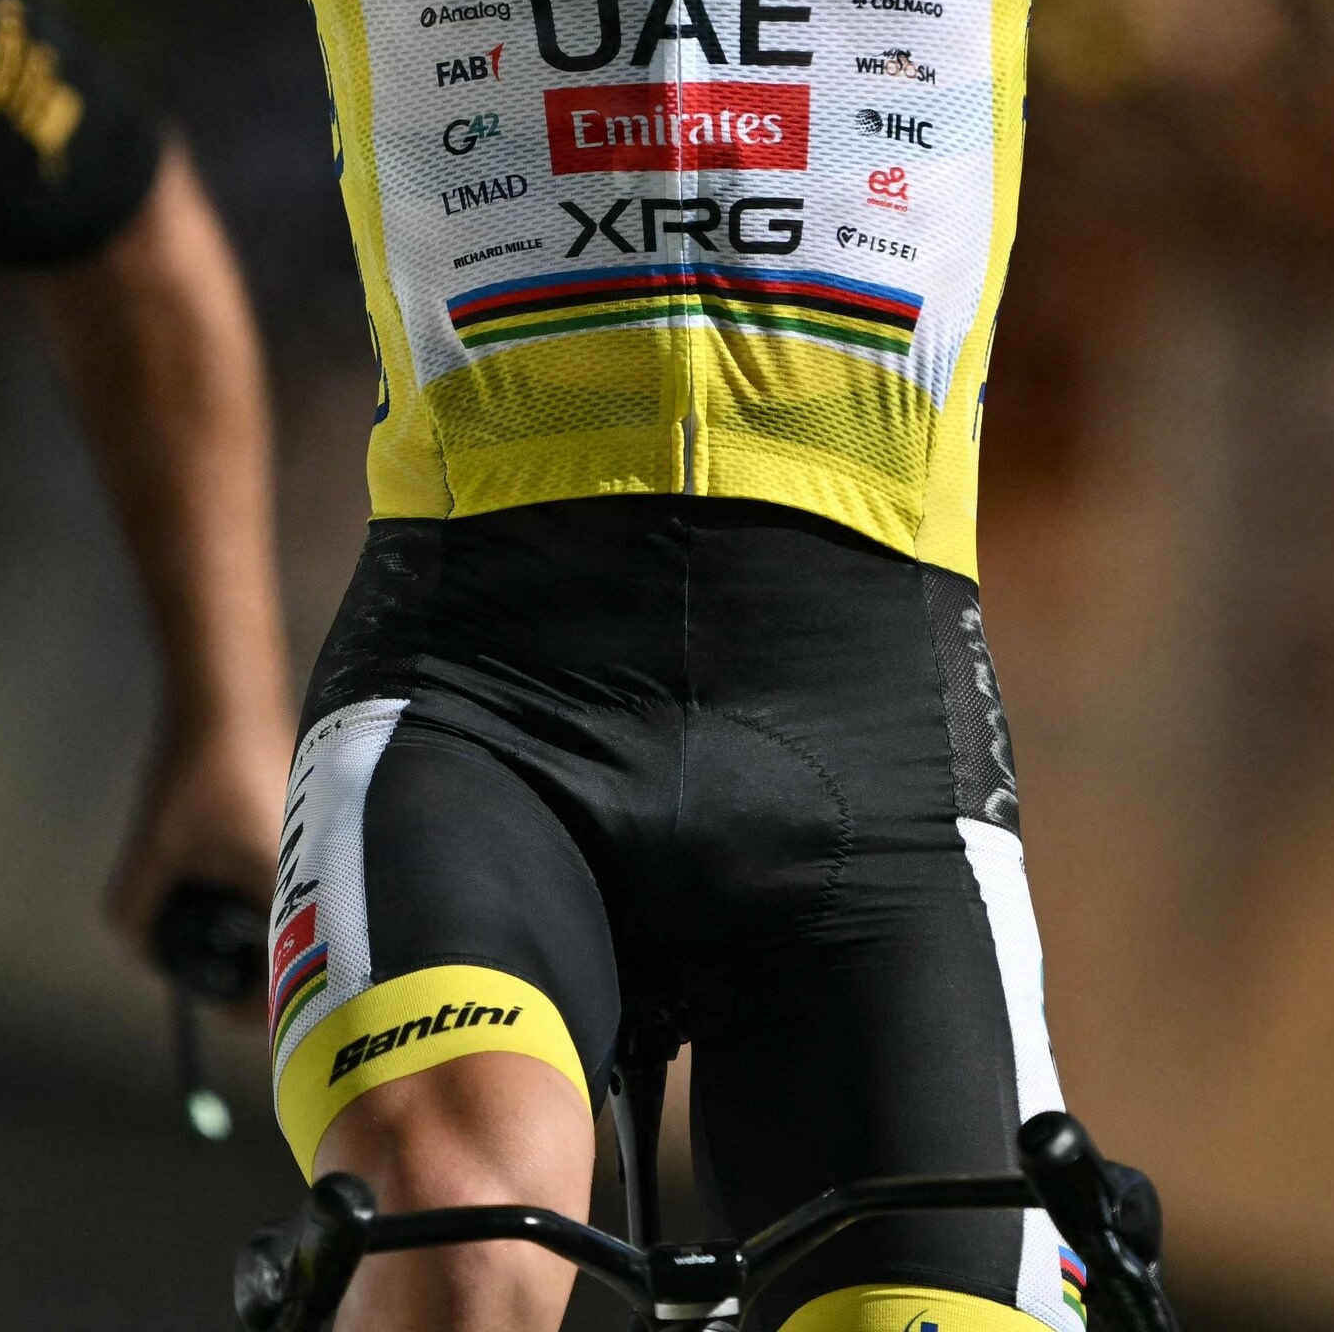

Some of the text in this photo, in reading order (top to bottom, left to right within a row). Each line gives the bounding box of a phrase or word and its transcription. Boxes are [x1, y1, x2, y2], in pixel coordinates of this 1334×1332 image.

[438, 0, 512, 21] Analog
[442, 112, 502, 156] G42
[570, 105, 783, 150] Emirates
[886, 113, 934, 150] IHC
[557, 197, 805, 258] XRG
[856, 232, 918, 262] PISSEI
[453, 238, 543, 269] RICHARD MILLE
[327, 998, 523, 1087] Santini
